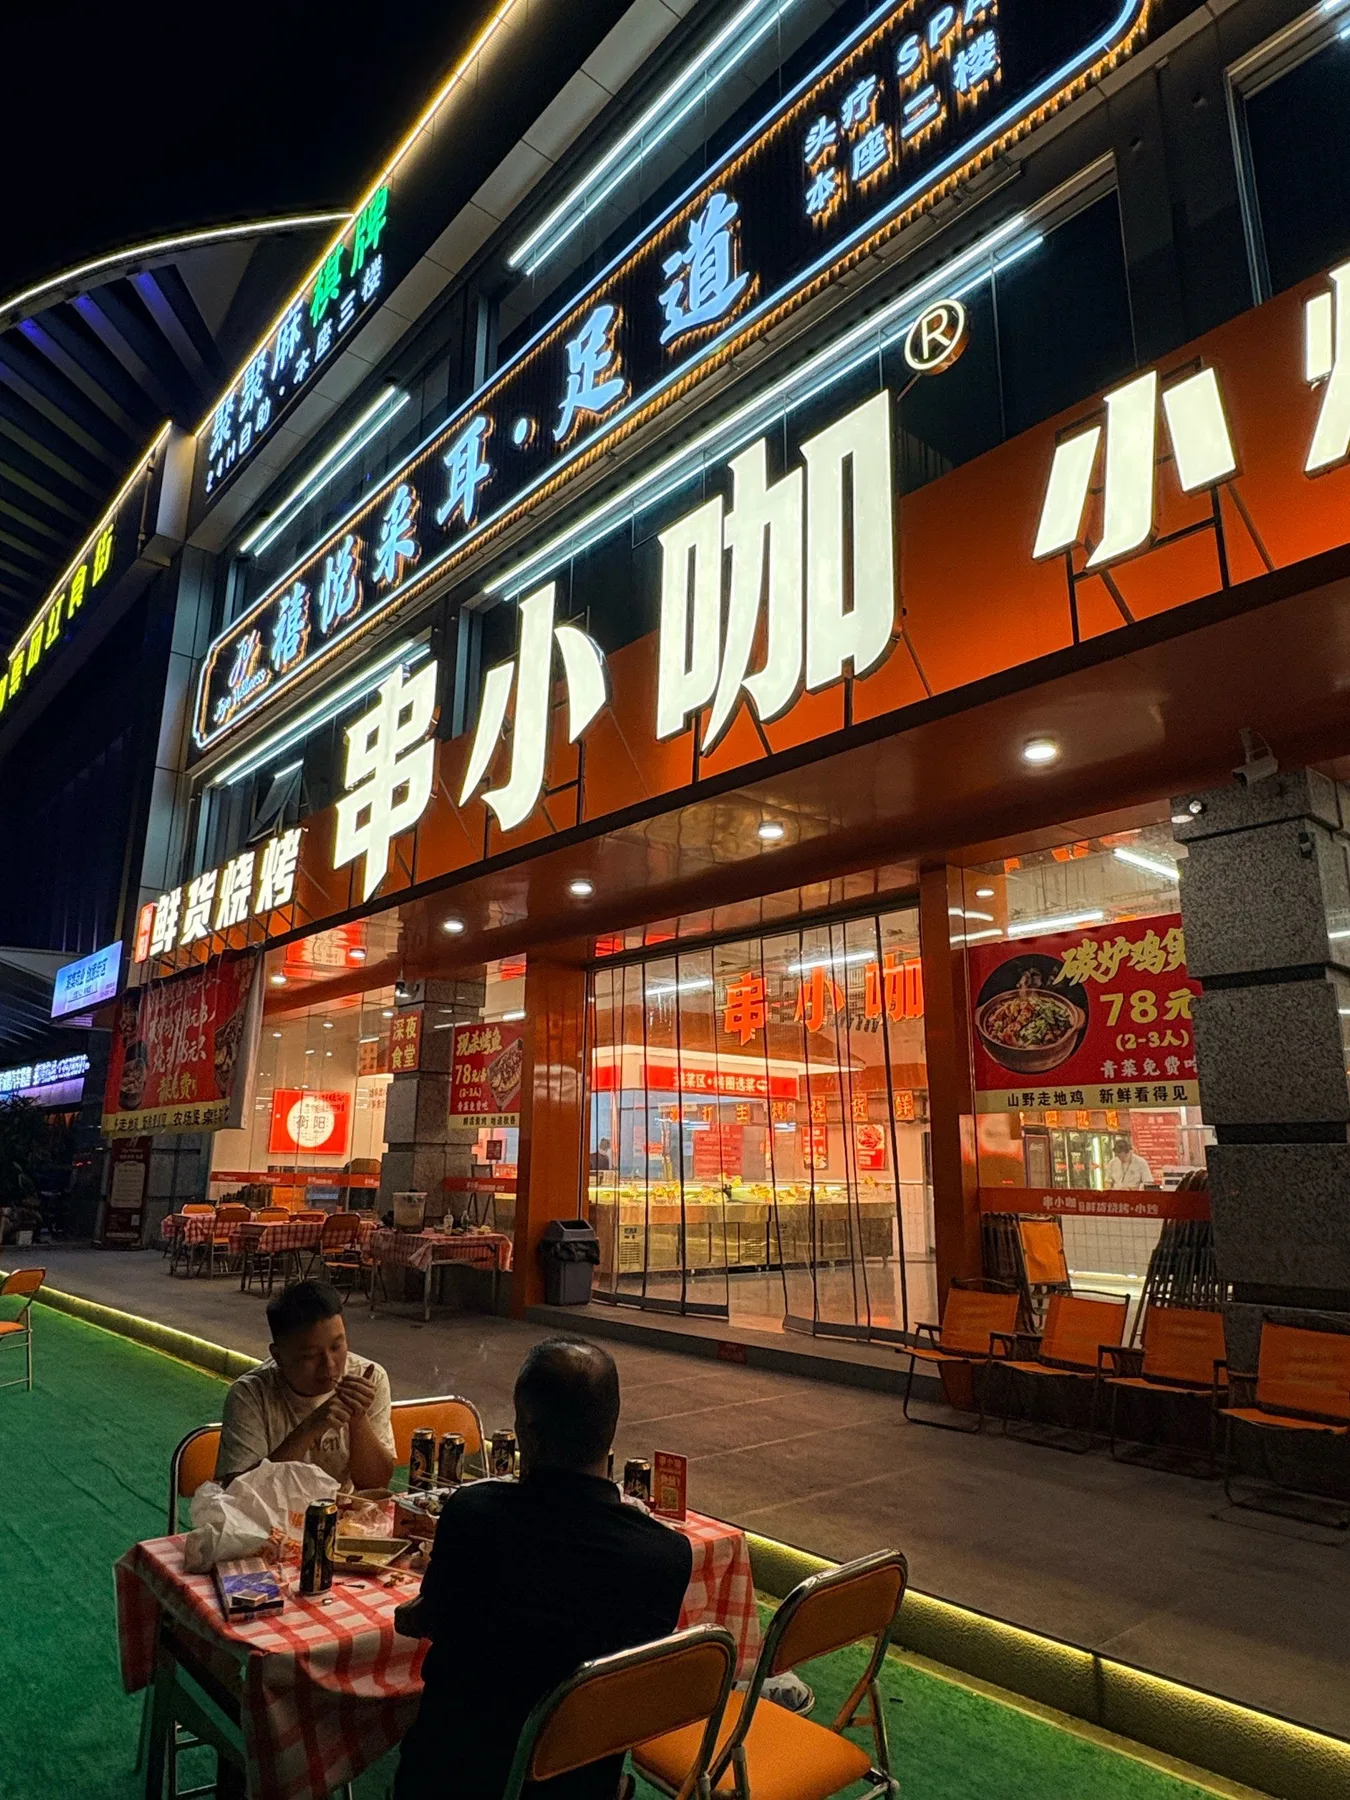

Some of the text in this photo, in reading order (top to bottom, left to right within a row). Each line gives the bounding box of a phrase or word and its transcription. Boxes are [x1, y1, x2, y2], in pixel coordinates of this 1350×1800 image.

[804, 74, 876, 164] 头疗
[806, 30, 996, 215] 本座二楼
[1033, 262, 1350, 568] 小
[333, 388, 894, 904] 串小咖
[149, 827, 302, 957] 鲜货烧烤
[392, 1015, 418, 1041] 深夜
[723, 952, 926, 1047] 串小咖
[1100, 987, 1196, 1027] 78元
[391, 1043, 416, 1069] 食堂
[455, 1026, 503, 1057] 现杀烤鱼
[1115, 1029, 1190, 1052] (2-3人)
[1007, 1085, 1188, 1109] 山野走地鸡 新鲜看得见
